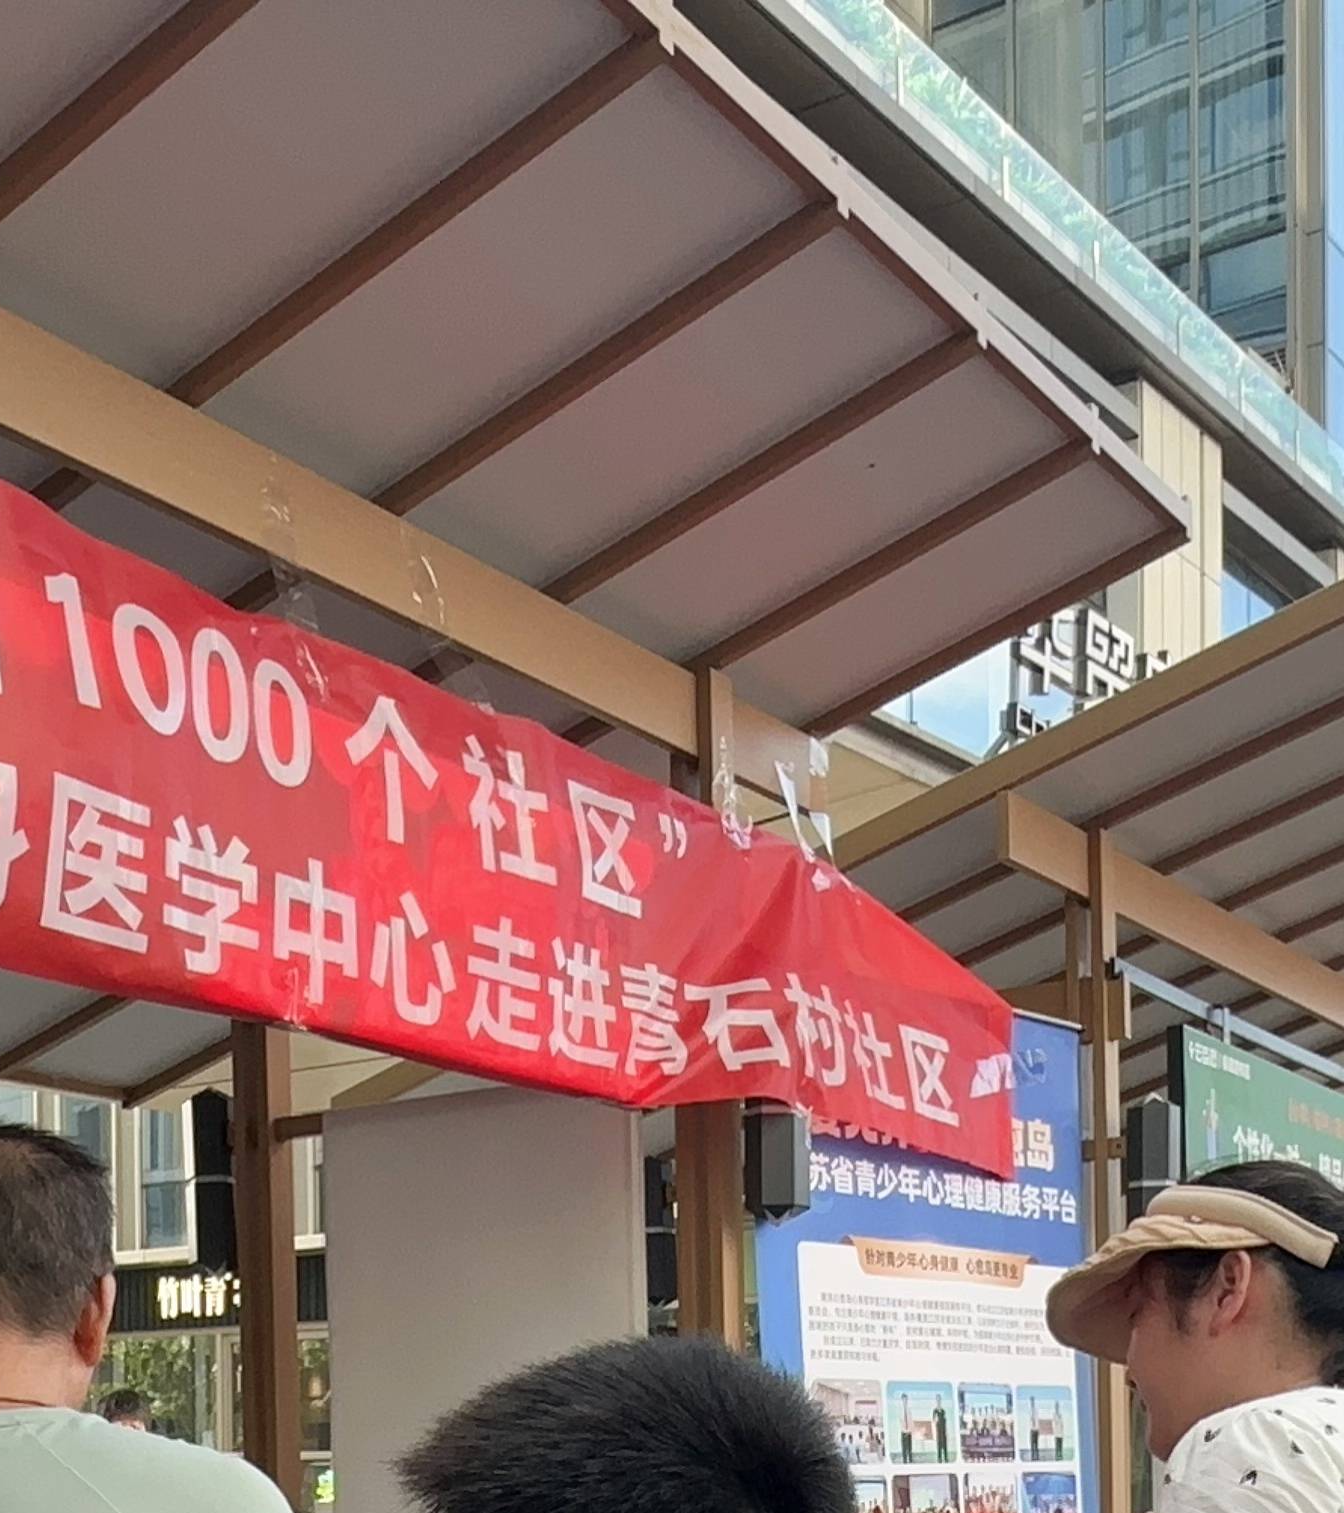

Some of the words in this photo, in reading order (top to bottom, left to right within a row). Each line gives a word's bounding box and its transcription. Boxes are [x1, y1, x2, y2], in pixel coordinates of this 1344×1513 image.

[808, 1152, 1077, 1225] 苏省青少年心理健康服务平台
[157, 1272, 241, 1321] 竹叶青
